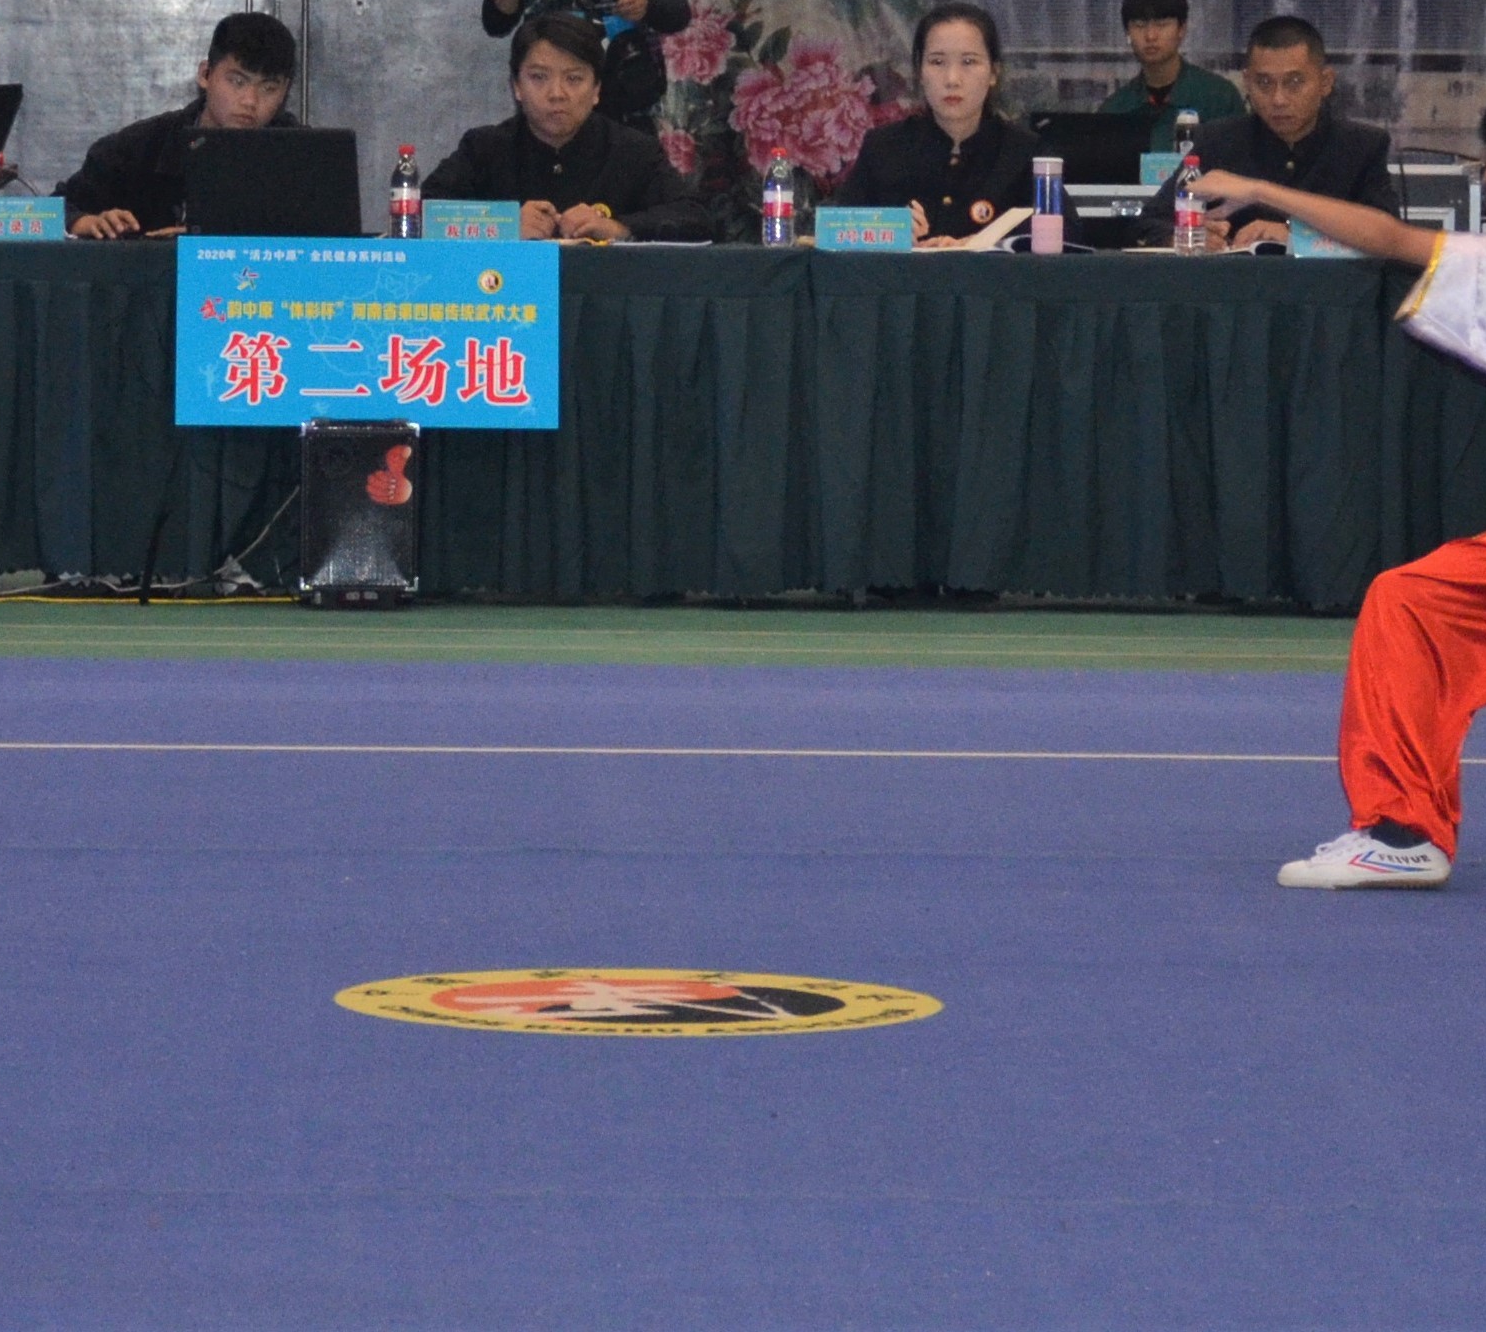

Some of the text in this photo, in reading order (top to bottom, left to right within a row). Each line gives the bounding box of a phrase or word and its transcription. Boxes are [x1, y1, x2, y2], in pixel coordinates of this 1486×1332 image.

[197, 249, 236, 261] 2020年
[219, 331, 530, 406] 第二场地
